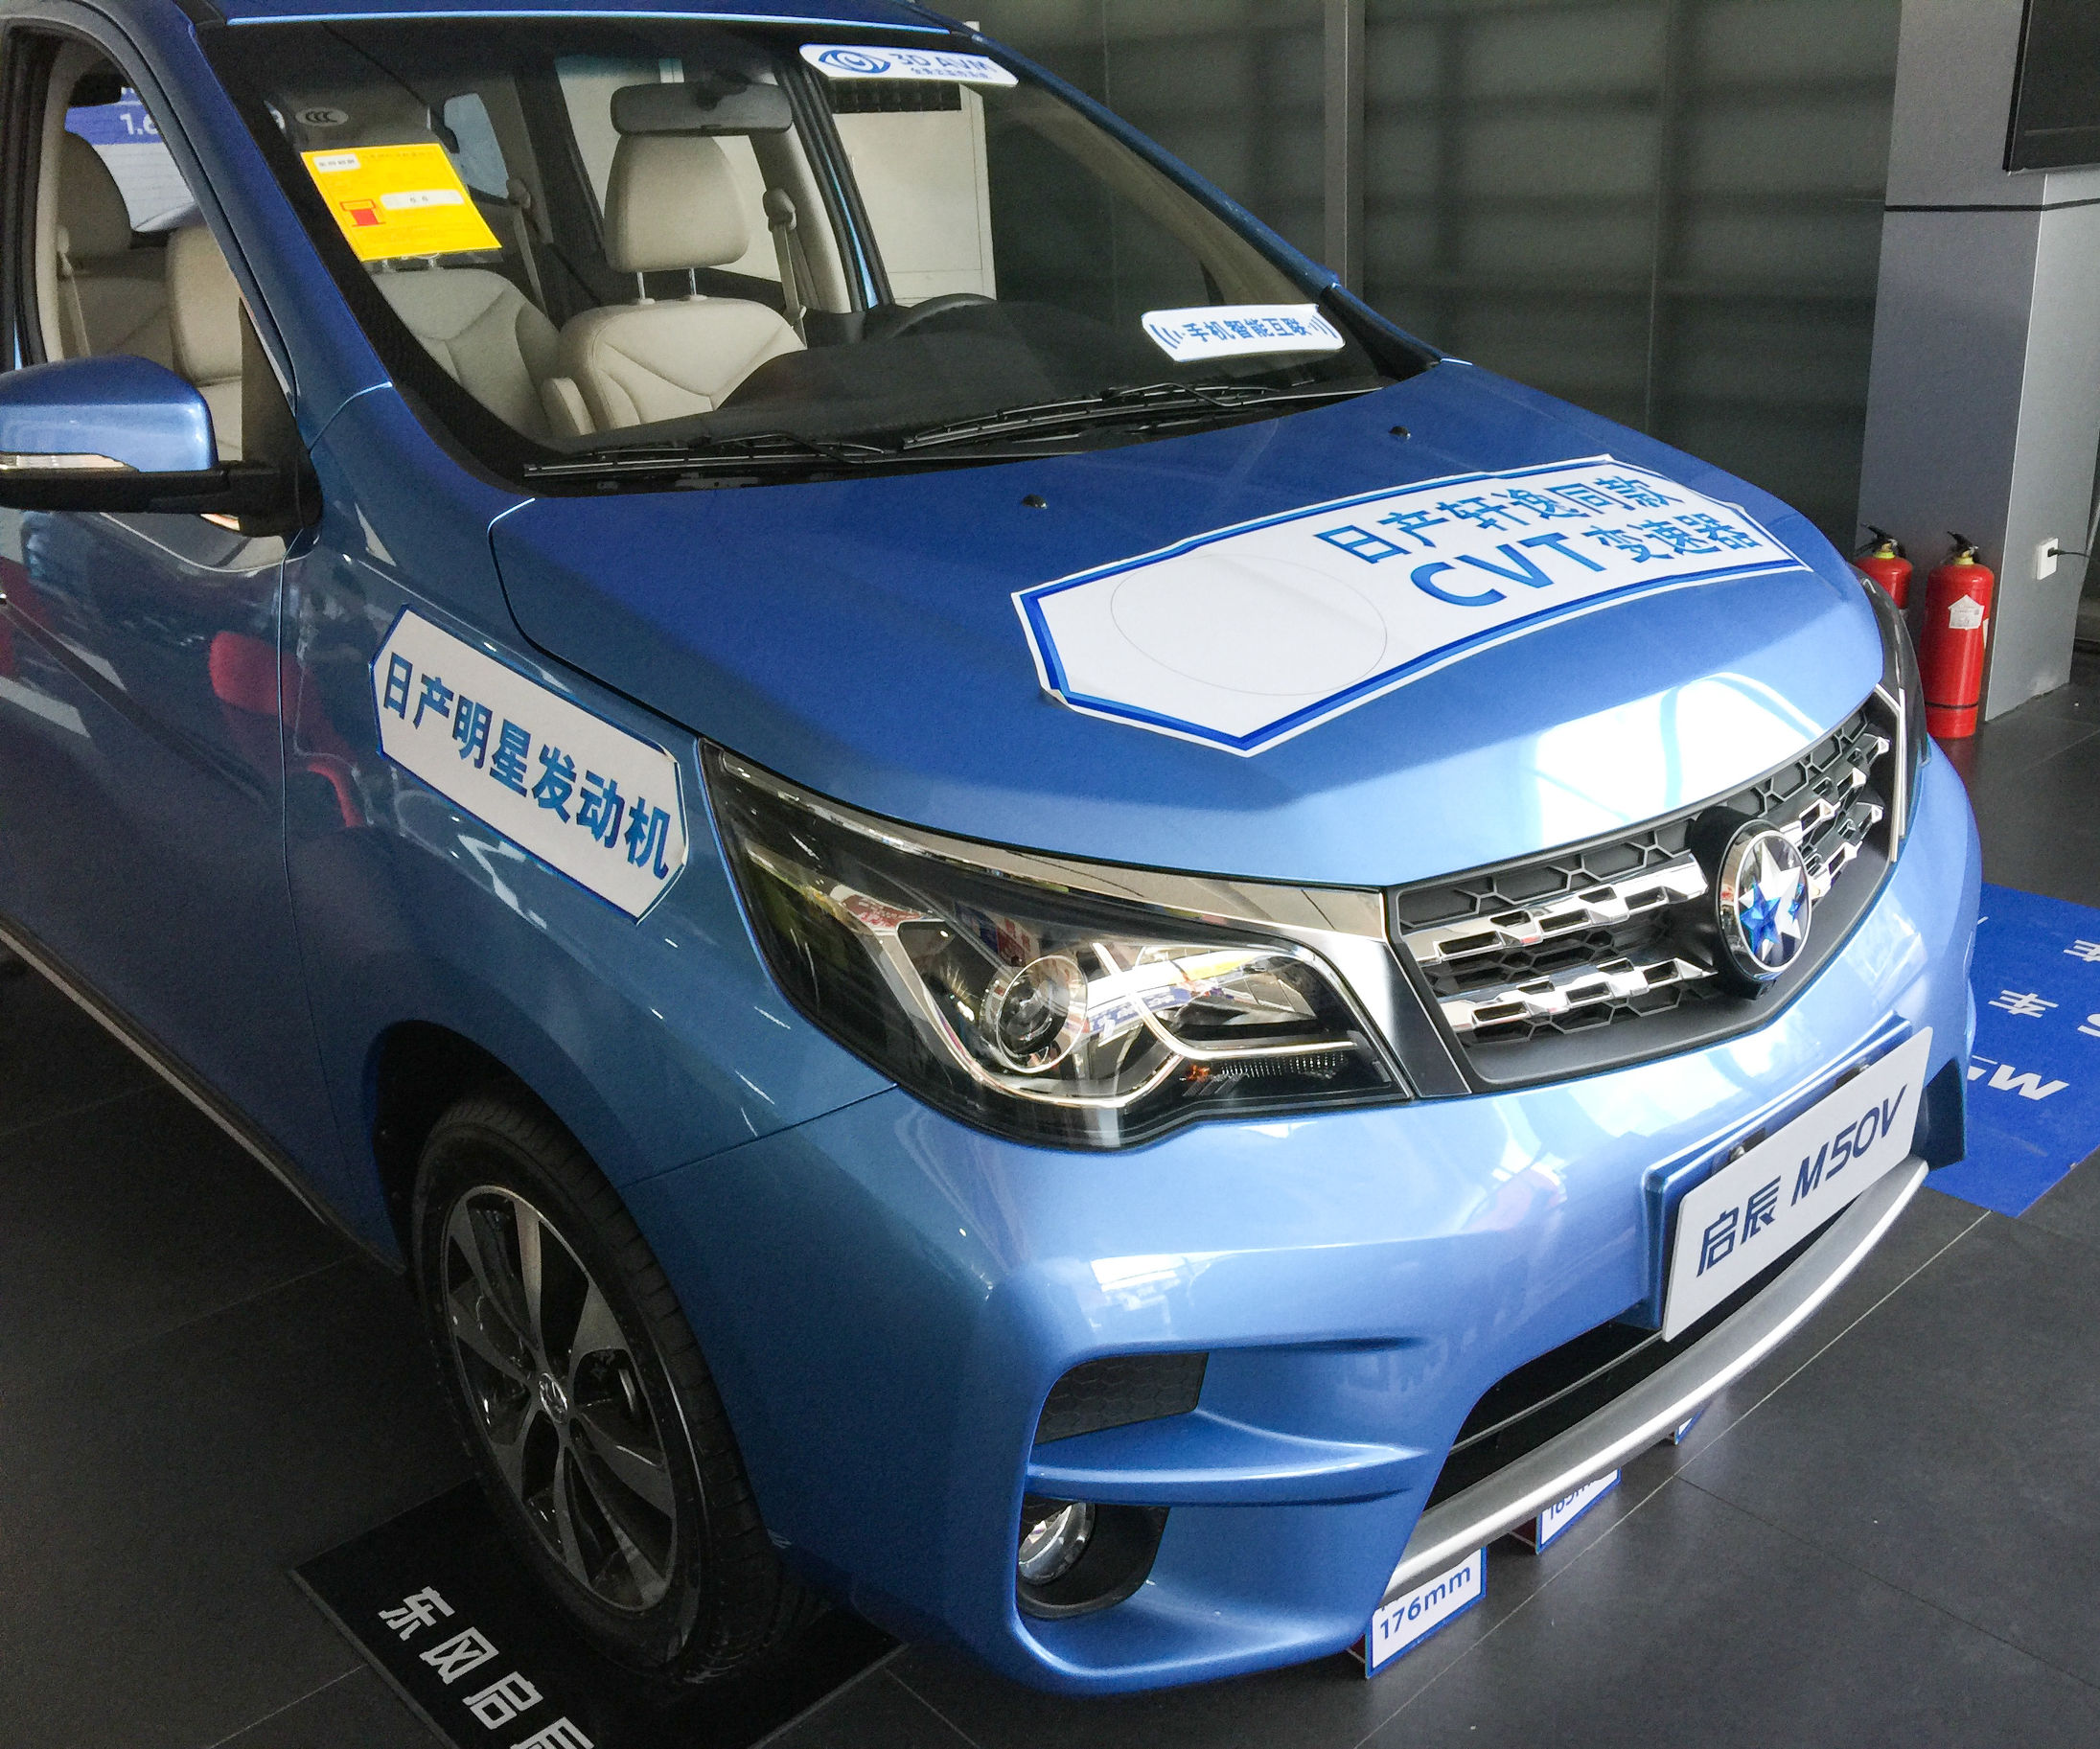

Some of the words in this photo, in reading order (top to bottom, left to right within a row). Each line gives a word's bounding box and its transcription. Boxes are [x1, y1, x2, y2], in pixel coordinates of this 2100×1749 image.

[1183, 317, 1313, 342] 手机智能互联
[1313, 475, 1686, 564] 日产轩逸同款
[1410, 532, 1608, 607] CVT
[1585, 513, 1765, 563] 变速器
[383, 652, 671, 880] 日产明星发动机
[1696, 1175, 1782, 1278] 启辰
[1790, 1083, 1908, 1208] M50V
[1380, 1566, 1471, 1640] 176mm
